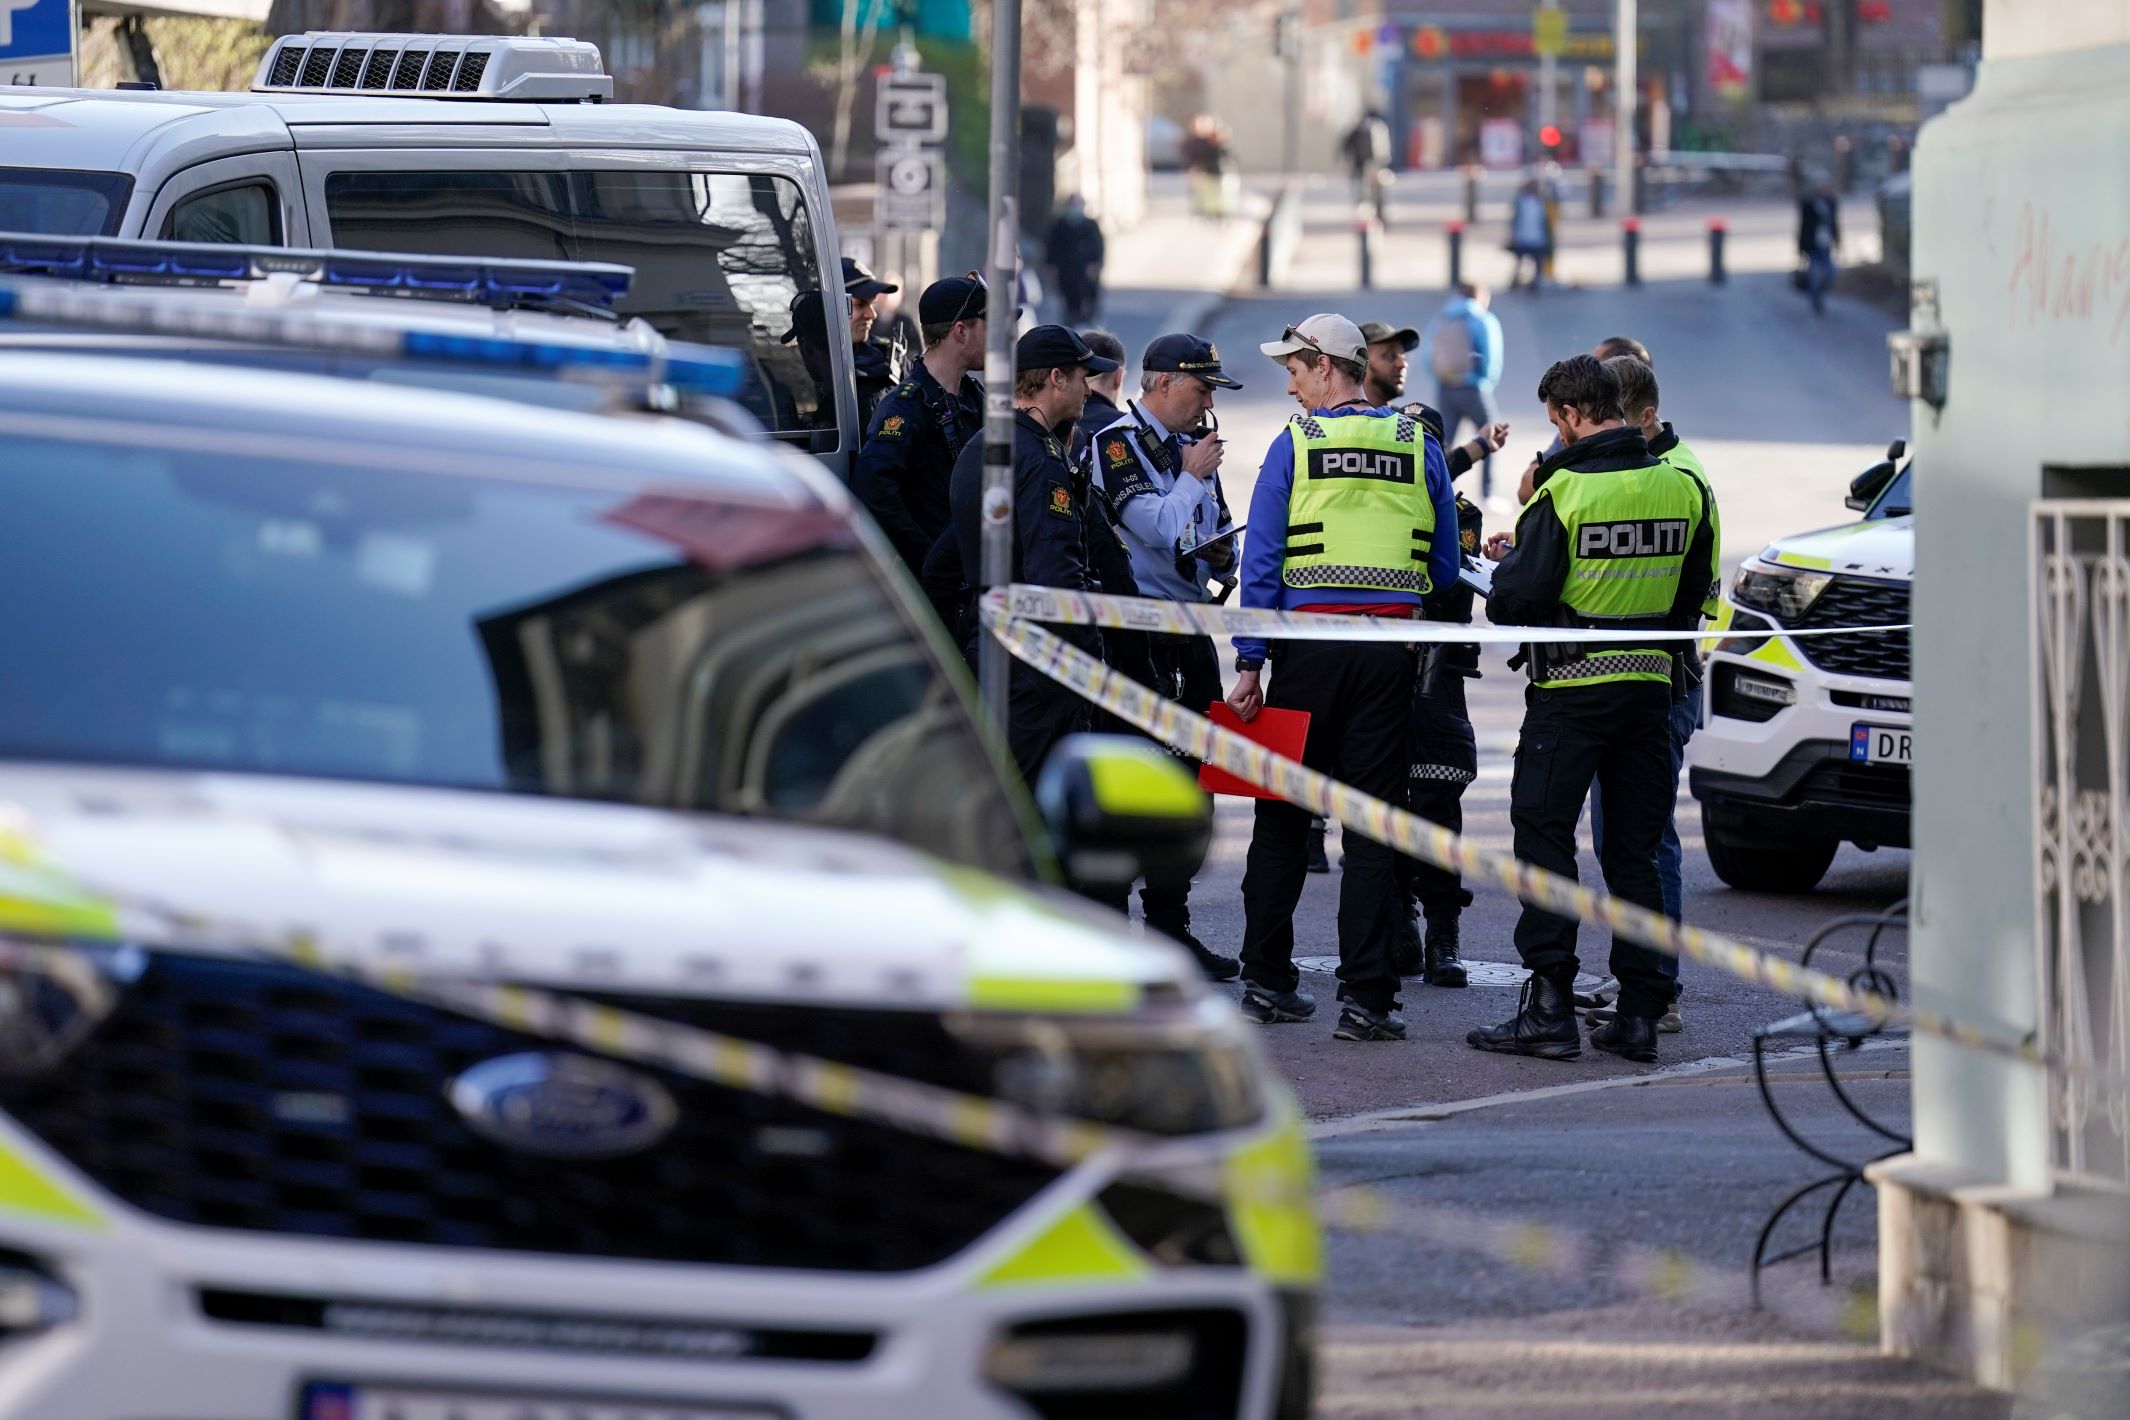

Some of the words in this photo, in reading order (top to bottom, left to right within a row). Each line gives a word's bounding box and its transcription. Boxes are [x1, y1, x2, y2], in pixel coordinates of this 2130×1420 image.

[1110, 458, 1134, 470] POLITI
[1322, 452, 1402, 478] POLITI
[1122, 473, 1139, 483] U-05
[1050, 504, 1072, 517] POLITI
[1580, 521, 1687, 556] POLITI
[1856, 746, 1865, 756] N
